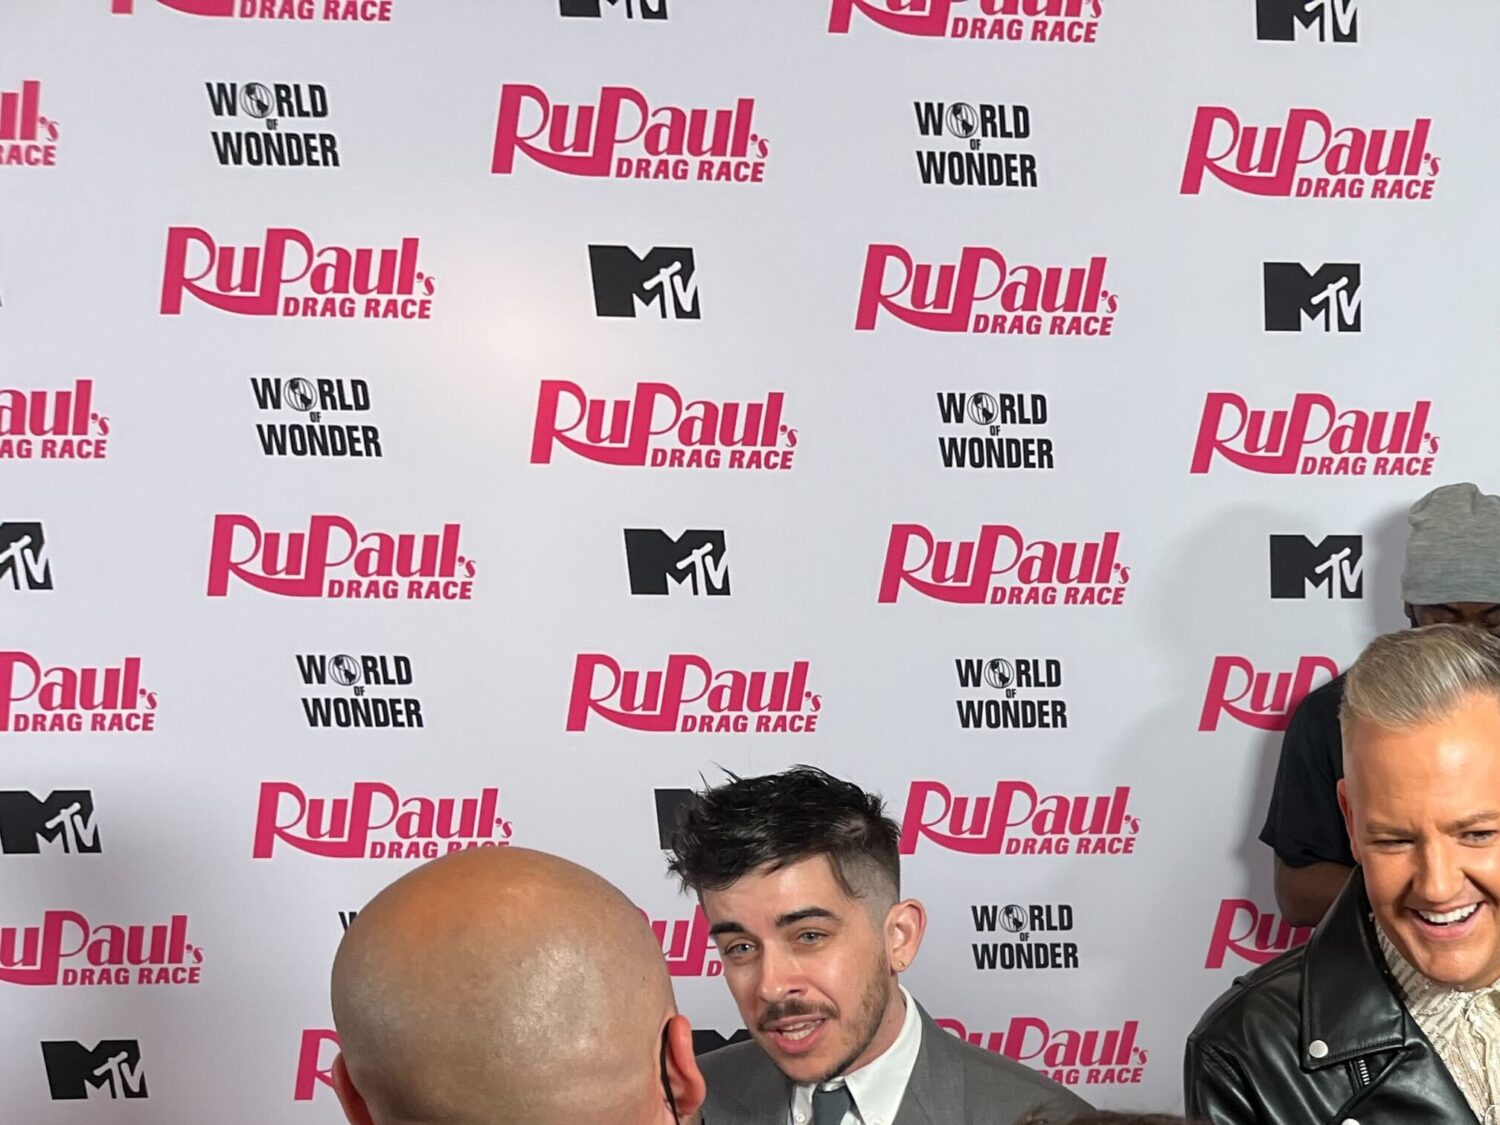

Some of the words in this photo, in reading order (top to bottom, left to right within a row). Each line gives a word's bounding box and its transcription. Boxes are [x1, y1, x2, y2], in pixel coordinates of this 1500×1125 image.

[950, 16, 1023, 40] DRAG
[1031, 19, 1098, 43] RACE
[491, 84, 770, 177] RuPaul's
[211, 131, 340, 167] WONDER
[1181, 106, 1441, 196] RuPaul's
[615, 156, 688, 180] DRAG
[696, 159, 765, 182] RACE
[916, 150, 1037, 187] WONDER
[1295, 177, 1364, 198] DRAG
[1370, 178, 1436, 199] RACE
[160, 227, 436, 316] RuPaul's
[587, 244, 701, 320] MTV
[856, 244, 1119, 332] RuPaul's
[1263, 261, 1361, 333] MTV
[282, 296, 355, 317] DRAG
[364, 297, 432, 319] RACE
[972, 313, 1042, 335] DRAG
[1049, 315, 1114, 336] RACE
[530, 380, 799, 466] RuPaul's
[1191, 392, 1440, 474] RuPaul's
[40, 438, 107, 458] RACE
[256, 424, 382, 457] WONDER
[938, 437, 1054, 468] WONDER
[650, 447, 720, 468] DRAG
[728, 449, 794, 469] RACE
[1300, 456, 1367, 475] DRAG
[1373, 456, 1434, 475] RACE
[208, 514, 477, 597] RuPaul's
[623, 528, 731, 596] MTV
[879, 524, 1131, 604] RuPaul's
[1269, 534, 1363, 599] MTV
[327, 579, 398, 599] DRAG
[406, 580, 473, 599] RACE
[990, 585, 1057, 604] DRAG
[1063, 586, 1126, 605] RACE
[567, 654, 822, 732] RuPaul's
[13, 712, 82, 732] DRAG
[90, 712, 154, 731] RACE
[301, 698, 424, 727] WONDER
[680, 714, 748, 732] DRAG
[755, 714, 818, 732] RACE
[956, 700, 1067, 729] WONDER
[0, 789, 102, 855] MTV
[253, 782, 514, 859] RuPaul's
[897, 781, 1141, 855] RuPaul's
[369, 840, 438, 858] DRAG
[1005, 836, 1069, 854] DRAG
[1075, 836, 1135, 854] RACE
[972, 943, 1079, 970] WONDER
[61, 966, 129, 986] DRAG
[137, 966, 201, 984] RACE
[40, 1039, 148, 1101] MTV
[1086, 1066, 1144, 1084] RACE
